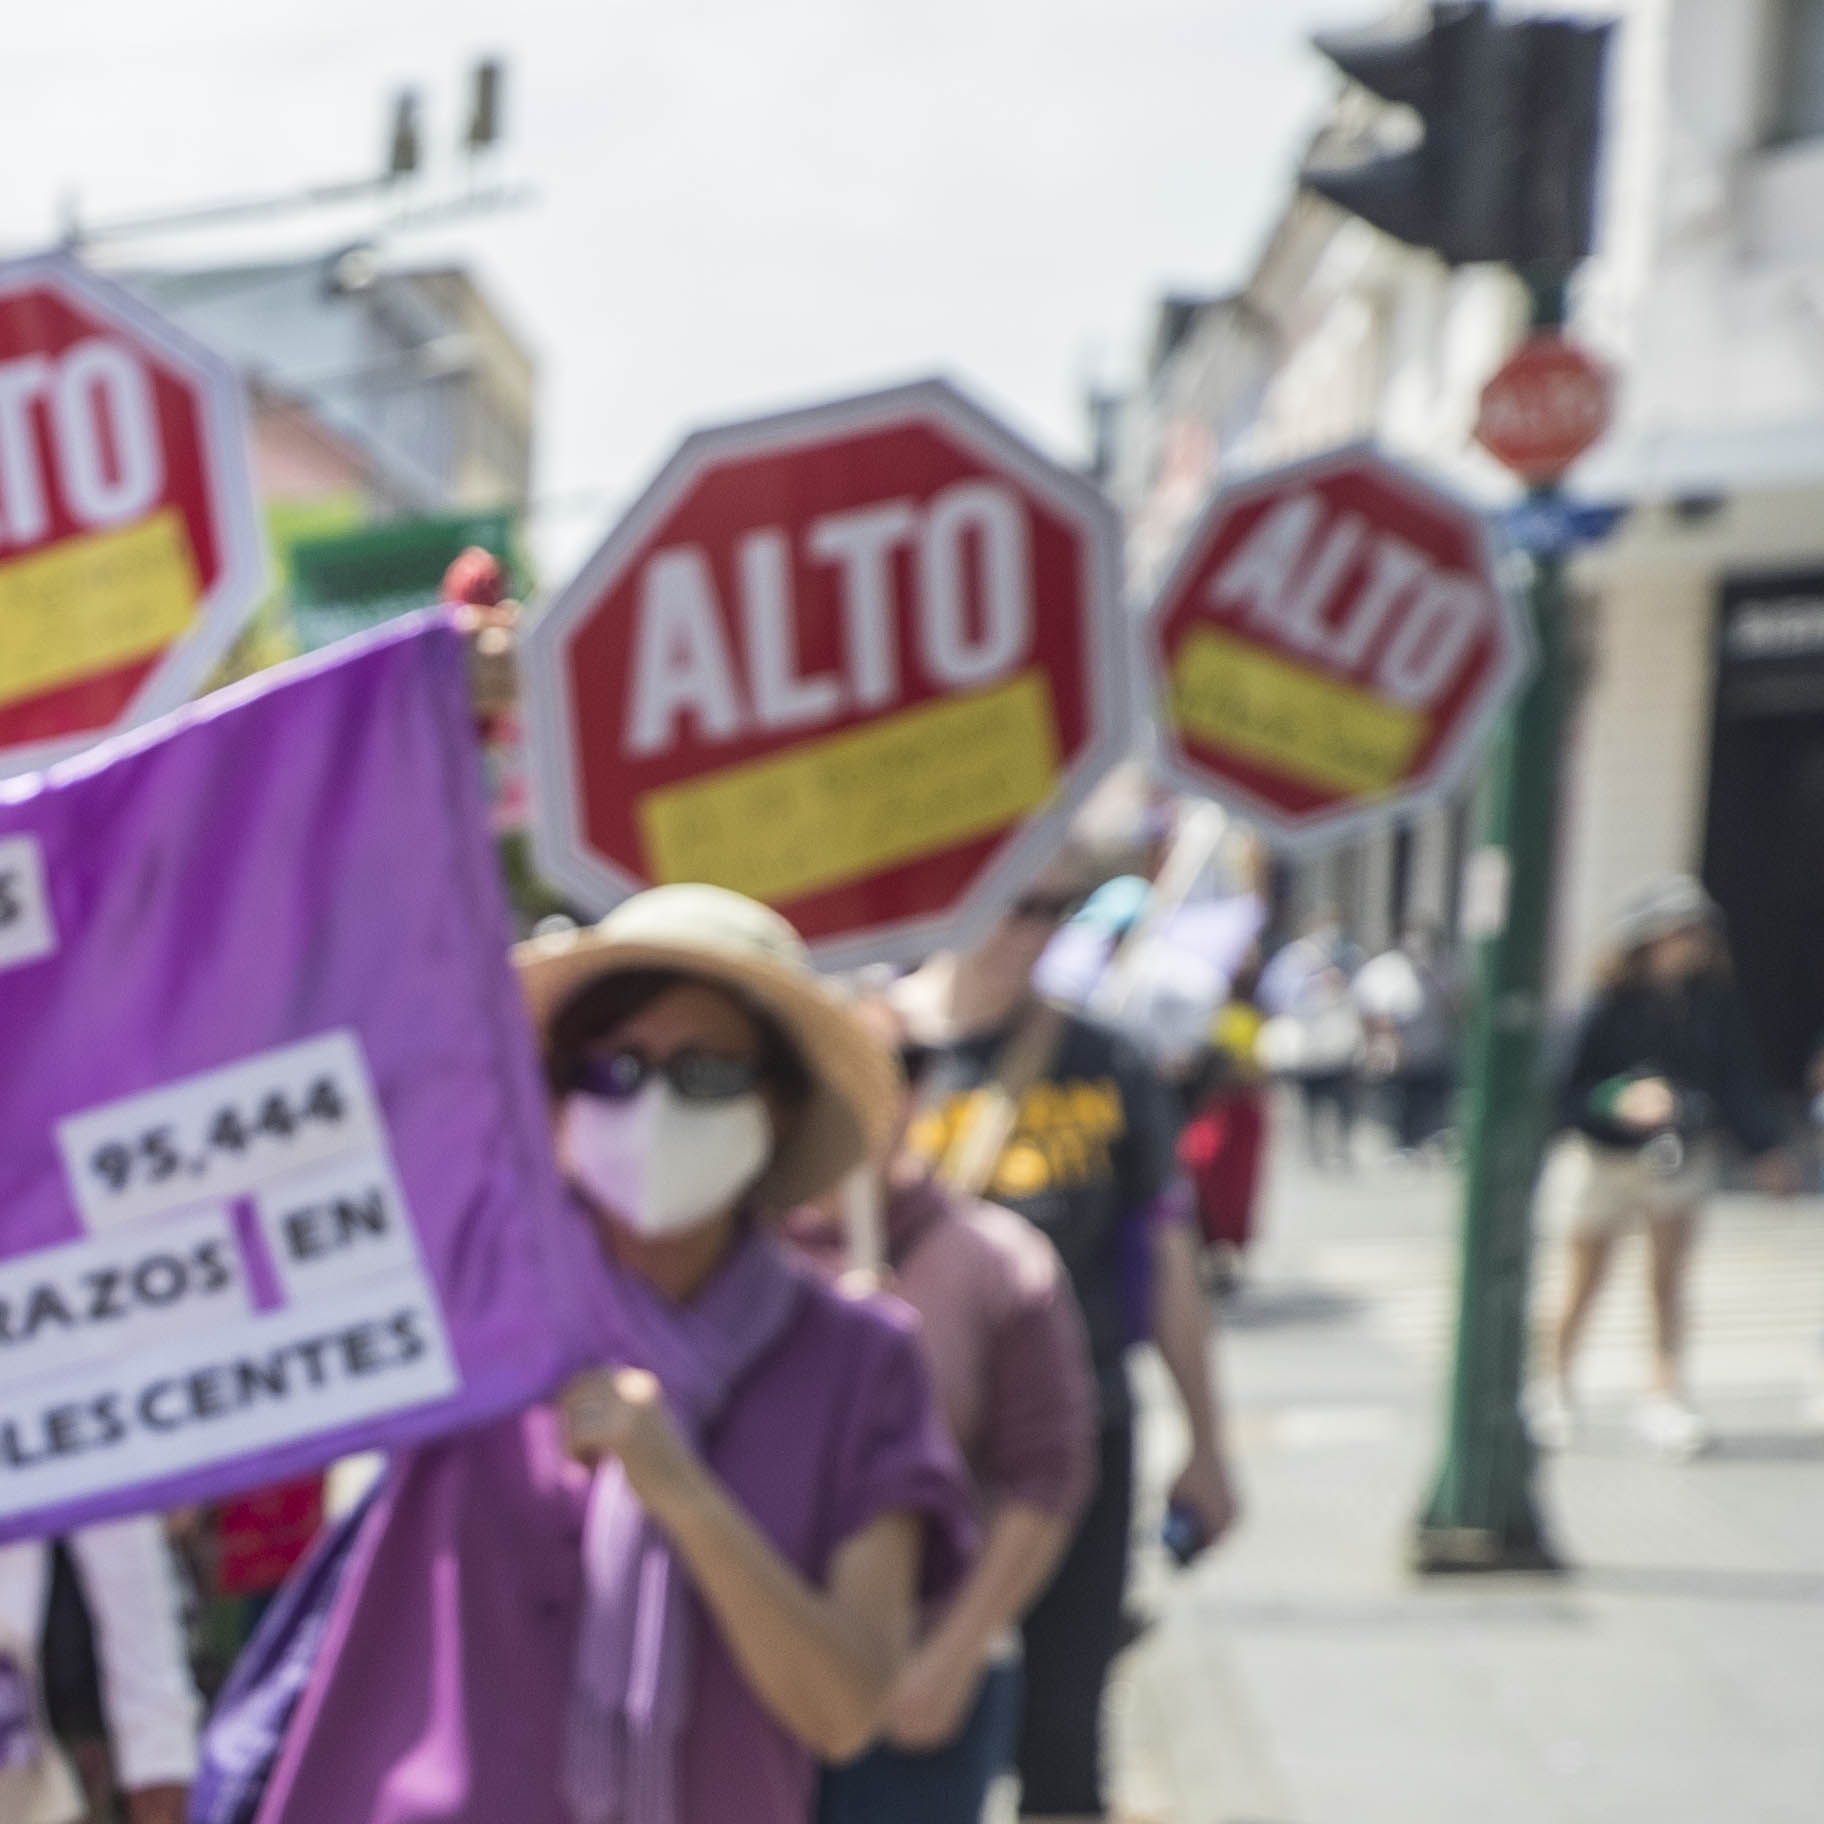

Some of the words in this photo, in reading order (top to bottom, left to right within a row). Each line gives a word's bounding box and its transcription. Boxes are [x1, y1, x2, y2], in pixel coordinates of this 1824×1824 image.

[626, 480, 1032, 758] ALTO
[1212, 492, 1480, 704] ALTO
[91, 1075, 346, 1194] 95,444
[282, 1190, 390, 1265] EN
